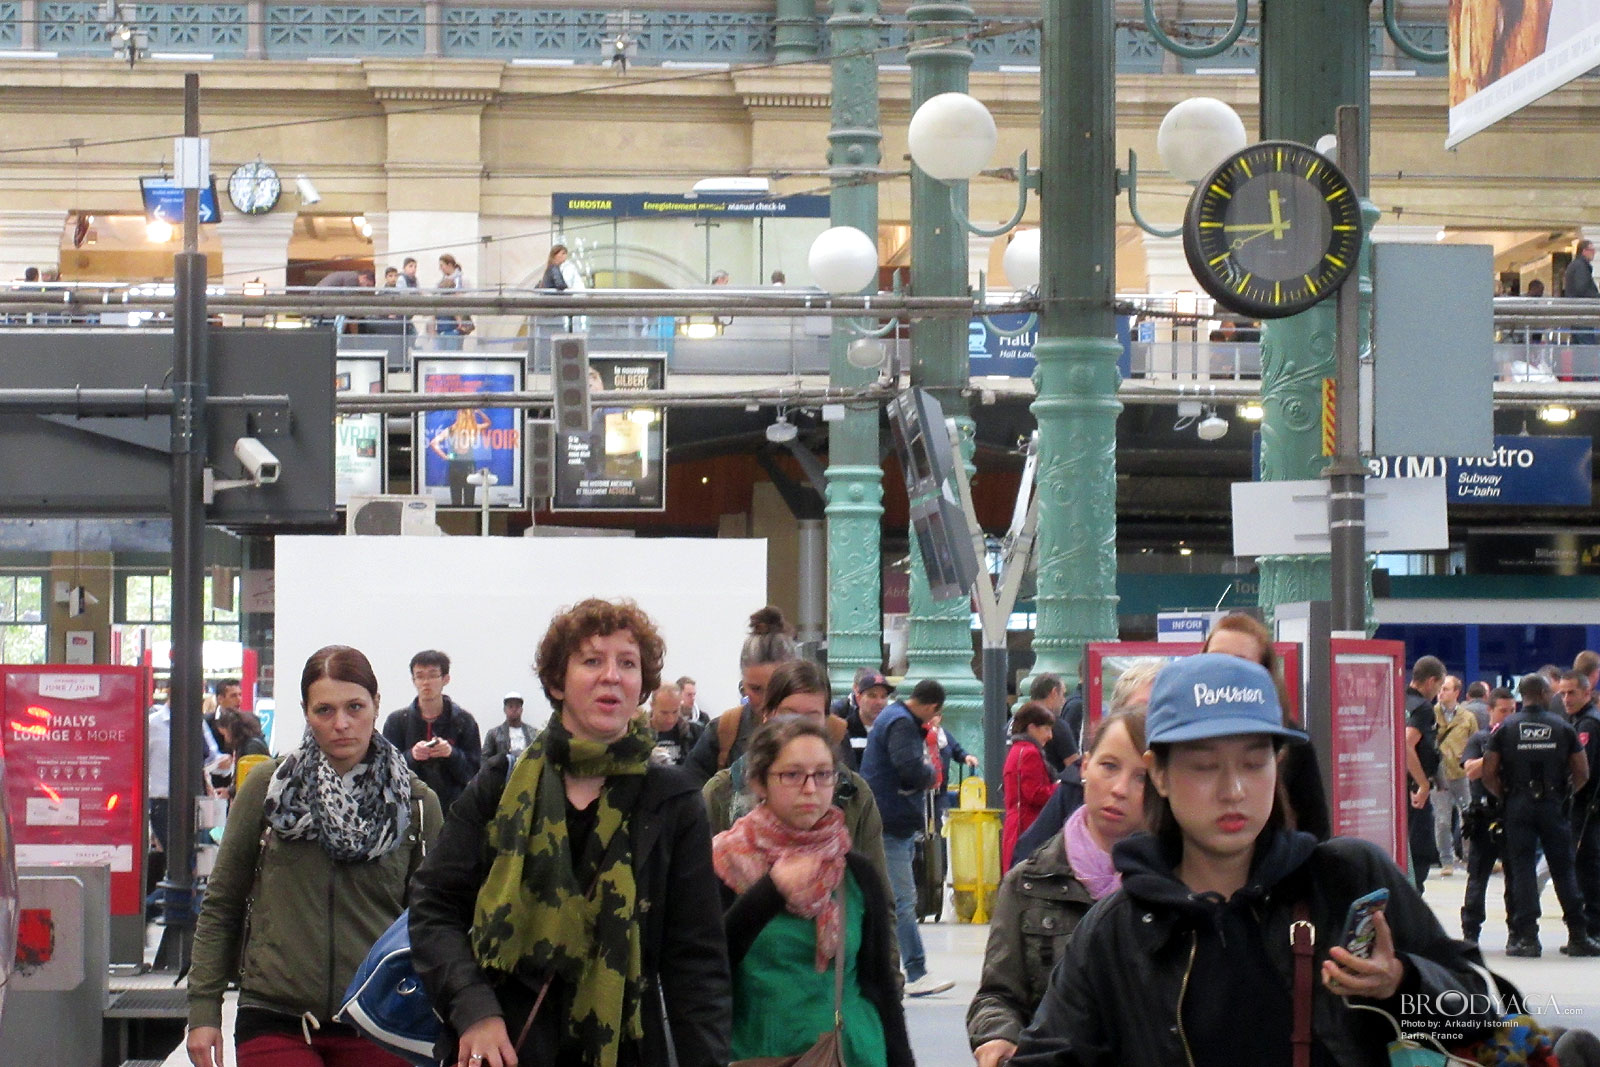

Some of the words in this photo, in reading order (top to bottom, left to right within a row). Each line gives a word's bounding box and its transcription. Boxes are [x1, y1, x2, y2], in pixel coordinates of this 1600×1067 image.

[568, 200, 613, 210] EUROSTAR
[999, 349, 1017, 359] Hall
[614, 374, 649, 387] GILBERT
[1458, 471, 1503, 486] Subway
[1458, 485, 1501, 497] U-bahn
[46, 715, 97, 728] THALYS
[13, 729, 70, 741] LOUNGE
[73, 730, 82, 741] &
[87, 730, 126, 742] MORE
